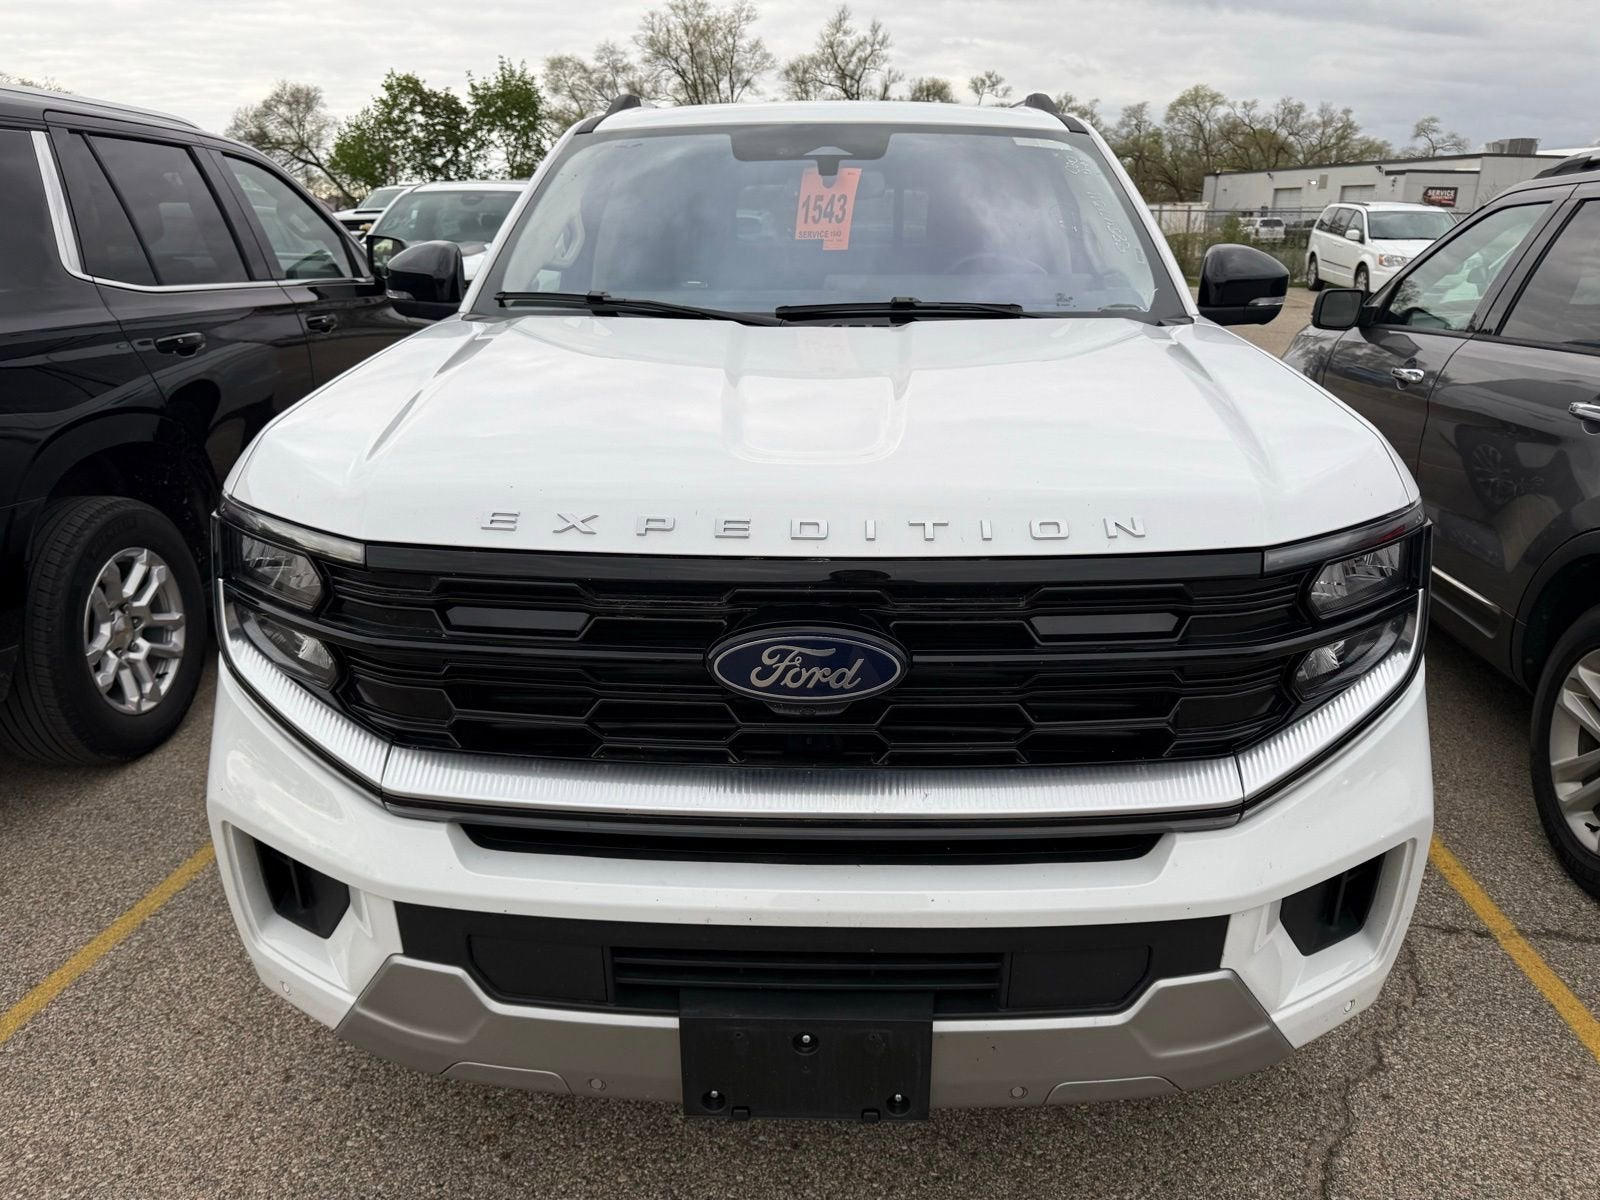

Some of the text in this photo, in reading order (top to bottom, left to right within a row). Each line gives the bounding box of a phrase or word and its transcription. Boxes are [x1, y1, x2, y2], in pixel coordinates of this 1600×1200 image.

[802, 193, 848, 224] 1543
[798, 230, 829, 239] SERVICE
[480, 511, 1146, 541] EXPEDITION
[750, 645, 865, 690] Ford
